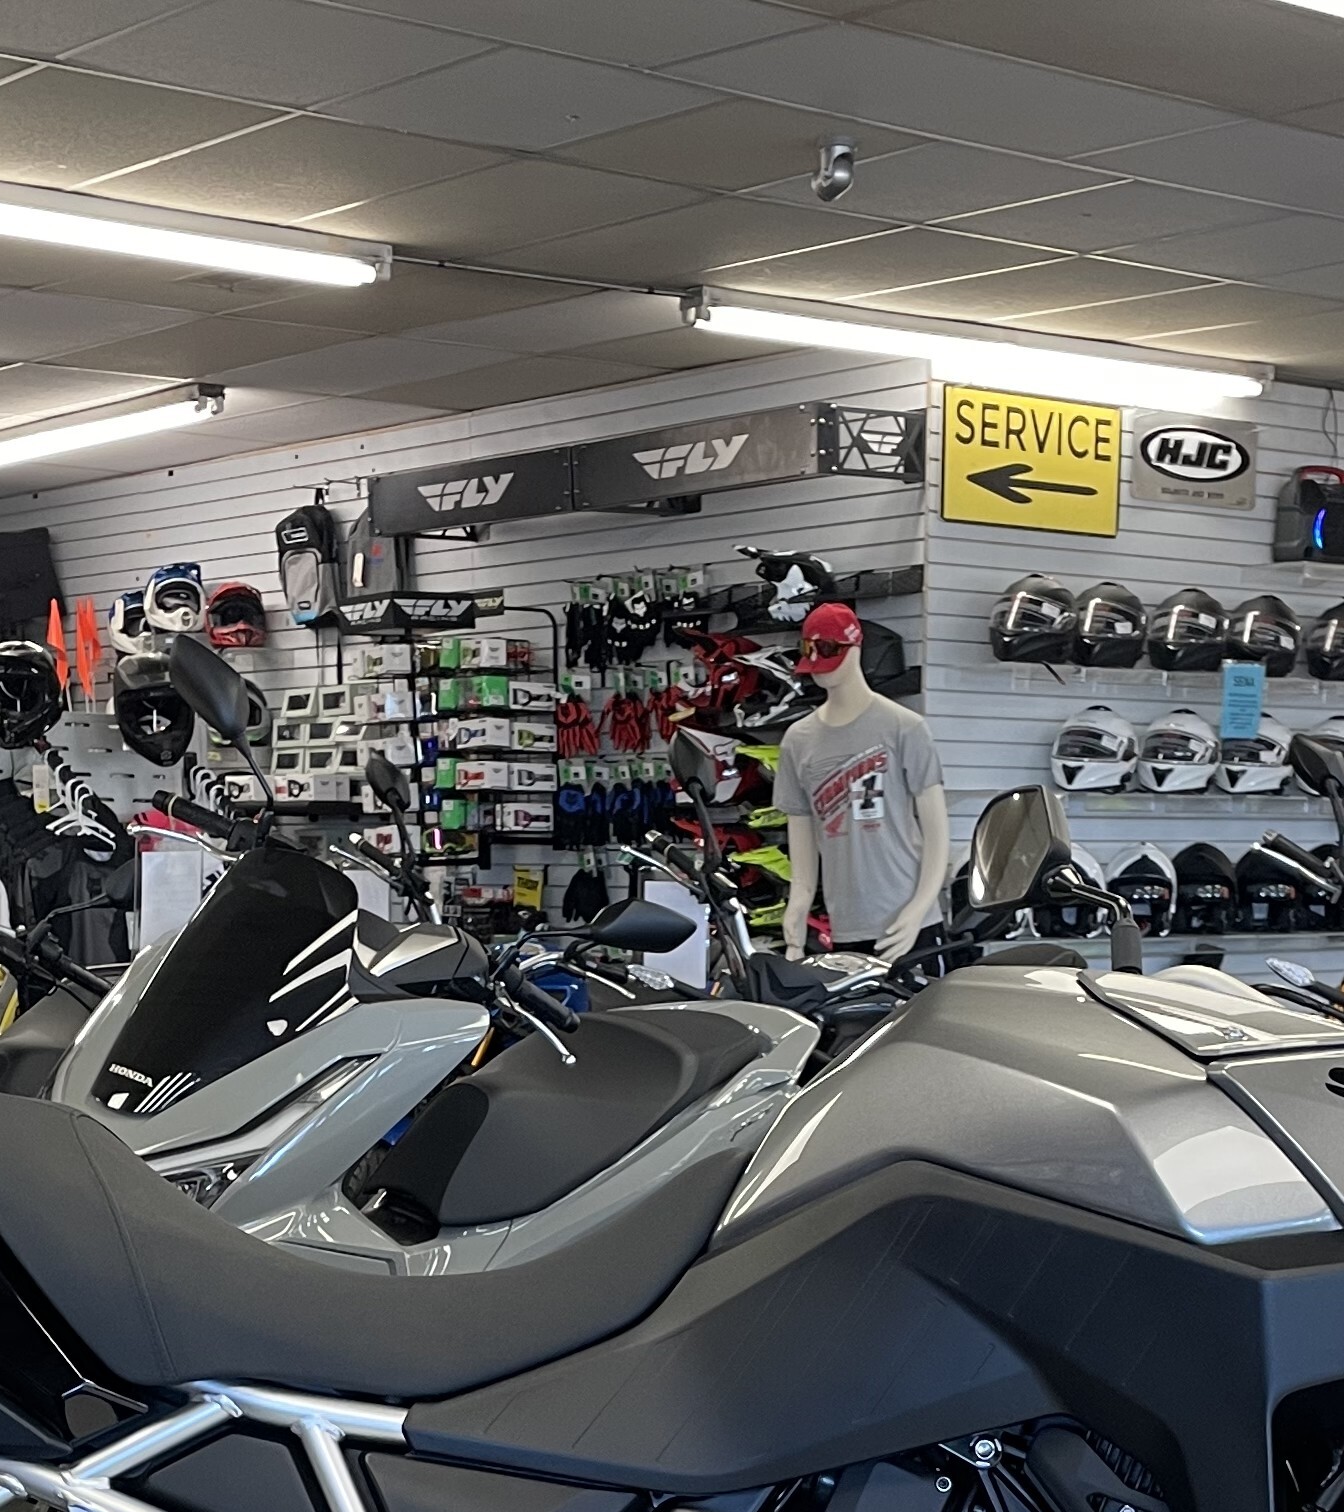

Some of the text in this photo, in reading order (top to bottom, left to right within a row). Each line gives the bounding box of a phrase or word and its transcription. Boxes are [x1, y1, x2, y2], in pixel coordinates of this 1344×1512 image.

[954, 399, 1112, 462] SERVICE
[632, 433, 751, 480] FLY
[1156, 437, 1233, 471] HJC
[417, 471, 515, 512] FLY
[339, 599, 391, 622] FLY
[393, 598, 473, 616] FLY
[108, 1062, 154, 1089] HONDA
